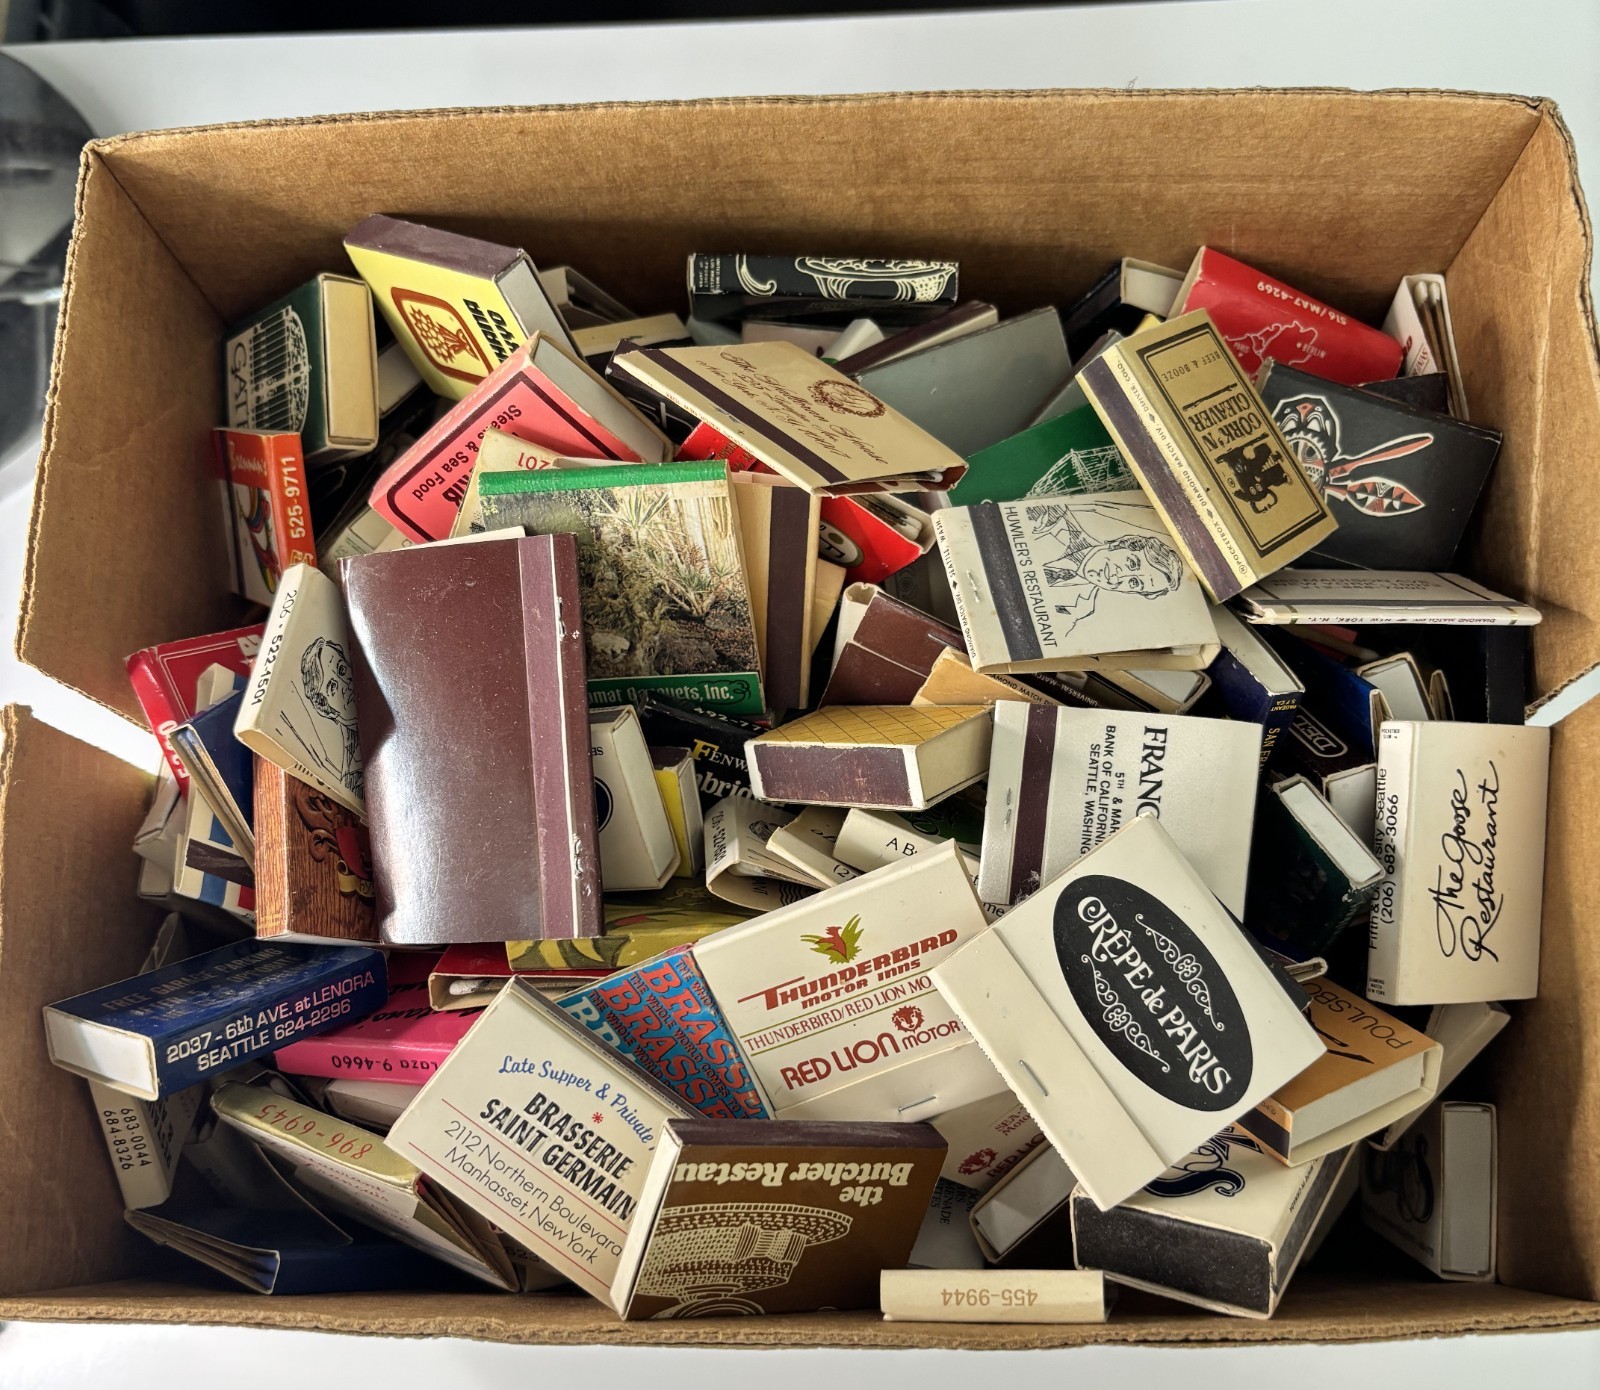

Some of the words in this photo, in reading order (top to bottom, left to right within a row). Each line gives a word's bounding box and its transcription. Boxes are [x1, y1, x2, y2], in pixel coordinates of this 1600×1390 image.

[462, 298, 509, 364] HANA
[1302, 344, 1328, 359] BERLIN
[1163, 365, 1192, 383] BOOZE
[1203, 350, 1221, 366] BEEF
[477, 404, 522, 440] Steas
[1188, 392, 1251, 432] CLEAVER
[441, 452, 469, 473] Sea
[466, 440, 480, 453] &
[282, 456, 307, 539] 525-9711
[412, 471, 446, 501] Food
[1004, 506, 1033, 567] HUWILER'S
[1023, 570, 1058, 648] RESTAURANT
[279, 589, 298, 620] 206
[958, 606, 968, 627] MATCH
[965, 627, 977, 658] DIAMOND
[251, 634, 284, 706] 522-1501
[988, 674, 1018, 690] AMOND
[1019, 687, 1043, 702] MATCH
[704, 684, 734, 700] Inc.
[1060, 684, 1098, 707] UNIVERSAL
[1103, 725, 1116, 756] BANK
[1264, 727, 1280, 748] SAN
[1292, 714, 1337, 751] DEL
[693, 739, 750, 772] FENW
[1088, 743, 1101, 796] SEATTLE,
[1102, 758, 1112, 775] OF
[1137, 725, 1168, 820] FRANC
[1115, 771, 1125, 790] 5TH
[1079, 798, 1095, 857] WASHING
[1095, 778, 1111, 847] CALIFORNI
[1108, 807, 1121, 837] MAR
[1441, 768, 1483, 865] Goose
[1386, 794, 1399, 875] 682-3066
[1369, 911, 1380, 950] Fifth
[1376, 768, 1387, 820] Seattle
[1460, 760, 1504, 962] Restaurant
[1381, 881, 1396, 924] (206)
[1428, 864, 1465, 958] The
[102, 992, 148, 1011] FREE
[149, 969, 215, 994] GARAGE
[215, 948, 284, 979] PARKING
[674, 960, 692, 981] THE
[737, 928, 958, 1011] THUNDERBIRD
[802, 978, 868, 1010] MOTOR
[876, 984, 907, 1008] LION
[907, 975, 932, 993] MO
[1077, 896, 1154, 991] CRÊPE
[1141, 981, 1165, 1014] de
[1158, 1006, 1231, 1094] PARIS
[165, 1031, 211, 1064] 2037
[225, 1016, 253, 1040] 6th
[255, 1001, 294, 1030] AVE.
[294, 996, 311, 1012] at
[311, 971, 375, 1007] LENORA
[197, 1034, 269, 1071] SEATTLE
[274, 999, 352, 1040] 624-2296
[588, 989, 606, 1012] THE
[605, 1011, 634, 1046] WHOLE
[633, 1046, 662, 1080] WORLD
[630, 973, 646, 995] THE
[648, 994, 676, 1029] WHOLE
[674, 1029, 702, 1062] WORLD
[701, 1063, 729, 1100] COMES
[727, 1099, 741, 1115] TO
[641, 962, 764, 1118] BRASSE
[779, 1057, 832, 1090] RED
[831, 1032, 901, 1072] LION
[901, 1019, 962, 1050] MOTOR
[332, 1056, 393, 1072] 9-4660
[499, 1055, 536, 1074] Late
[538, 1061, 592, 1092] Supper
[596, 1083, 611, 1099] &
[254, 1104, 373, 1159] 896-6945
[524, 1091, 635, 1181] BRASSERIE
[1002, 1114, 1031, 1136] Moto
[444, 1120, 483, 1153] 2112
[481, 1145, 549, 1205] Northern
[480, 1099, 547, 1153] SAINT
[542, 1143, 638, 1222] GERMAIN
[674, 1161, 790, 1188] Restau
[790, 1161, 915, 1188] Butcher
[985, 1155, 1017, 1178] RED
[1016, 1133, 1047, 1156] LIO
[445, 1146, 529, 1217] Manhasset,
[527, 1209, 568, 1239] New
[565, 1231, 602, 1265] York
[839, 1185, 884, 1208] the
[940, 1182, 957, 1224] MENADE
[941, 1288, 1039, 1308] 455-9944
